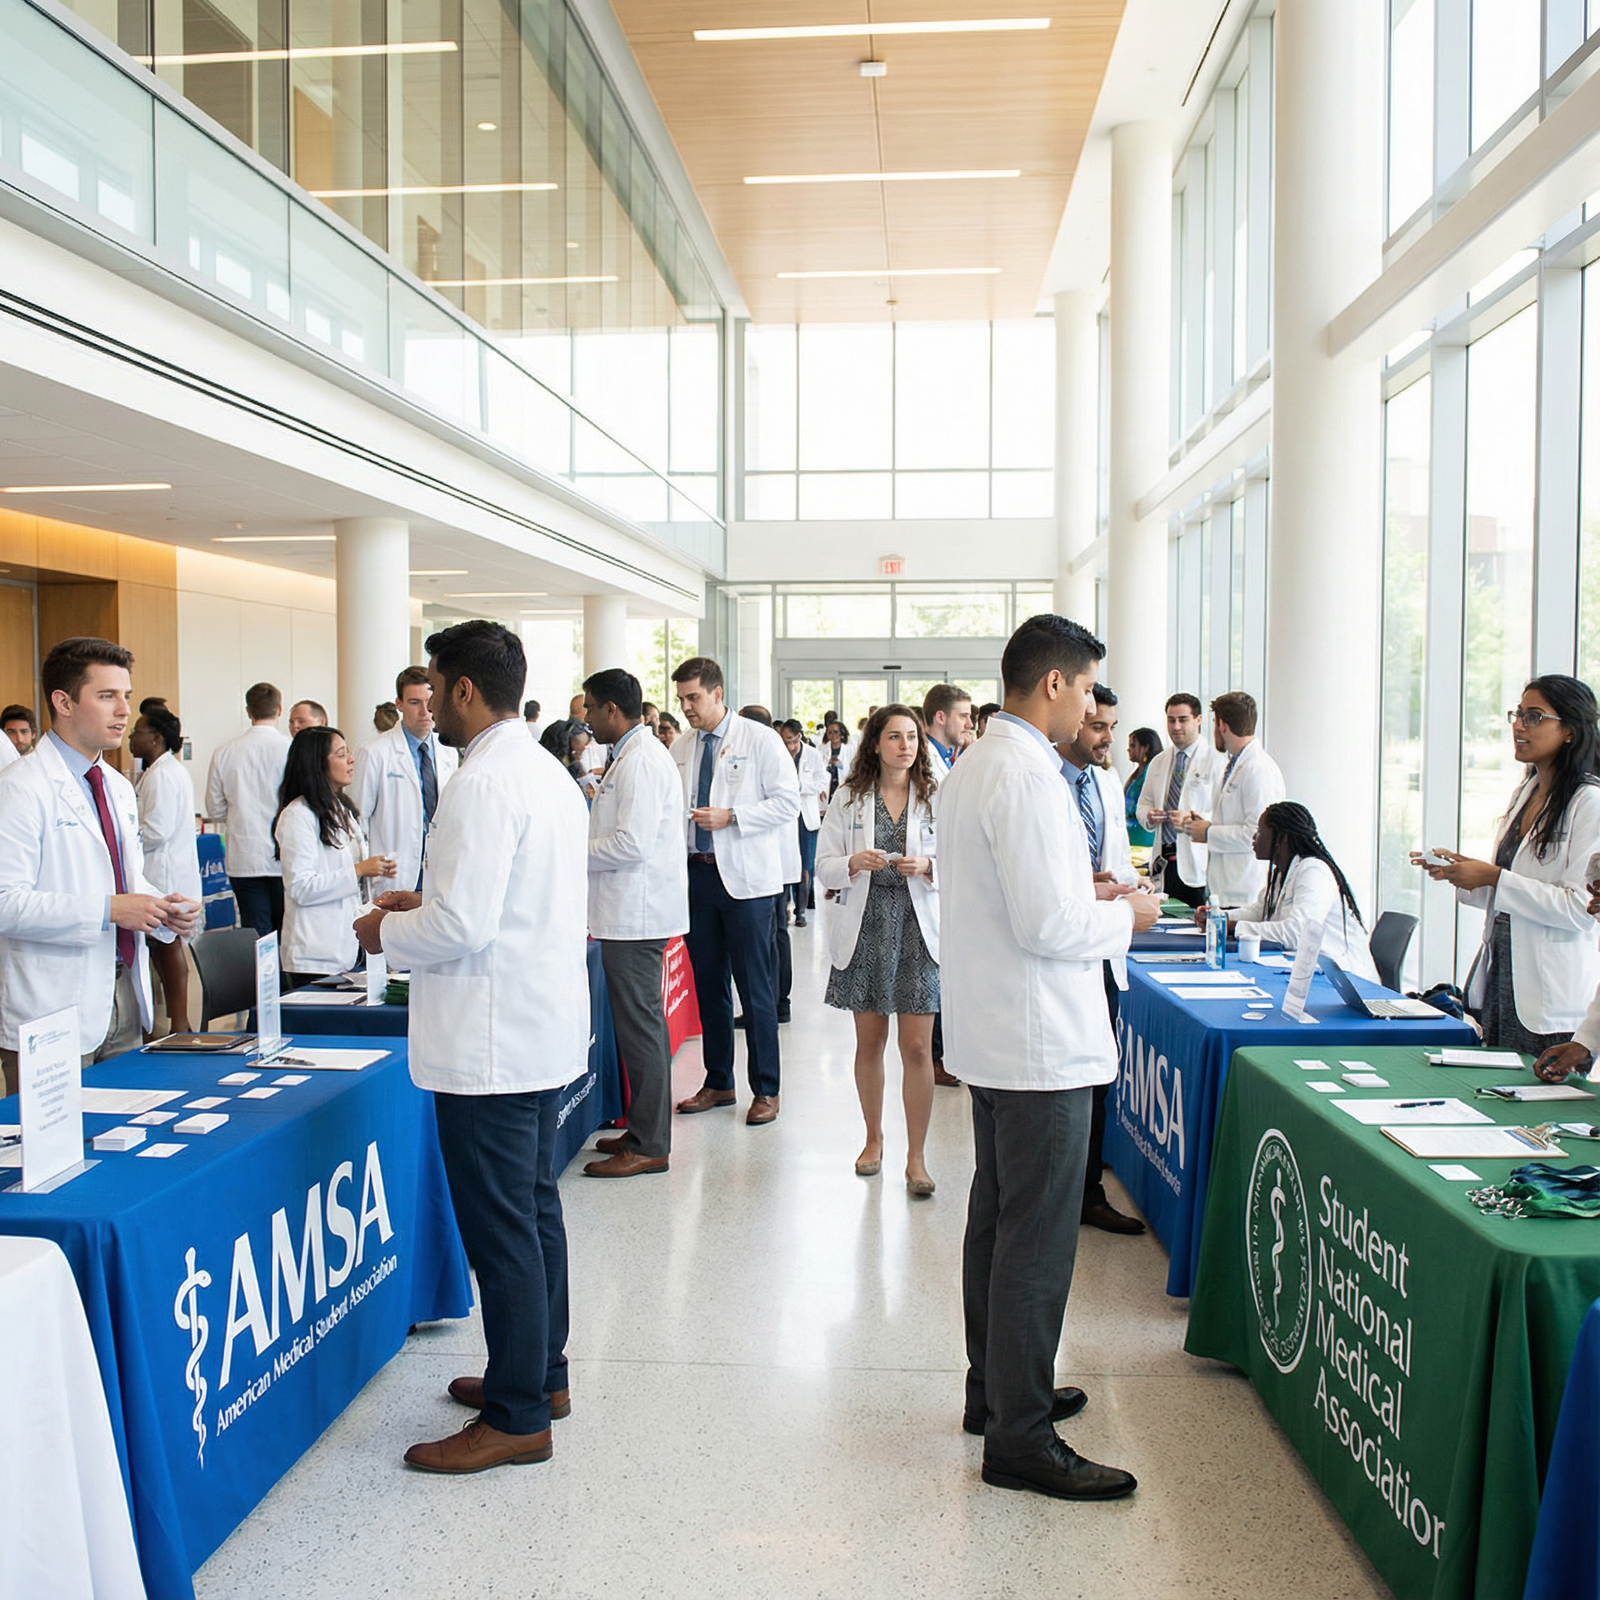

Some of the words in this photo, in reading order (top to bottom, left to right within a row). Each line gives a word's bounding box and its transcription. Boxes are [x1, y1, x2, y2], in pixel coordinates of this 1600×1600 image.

[1122, 1023, 1185, 1170] AMSA
[218, 1140, 395, 1391] AMSA
[1318, 1175, 1409, 1299] Student
[1318, 1237, 1412, 1378] National
[216, 1371, 271, 1437] American
[273, 1330, 314, 1381] Medical
[315, 1296, 348, 1344] Student
[349, 1254, 397, 1310] Association
[1315, 1299, 1402, 1441] Medical
